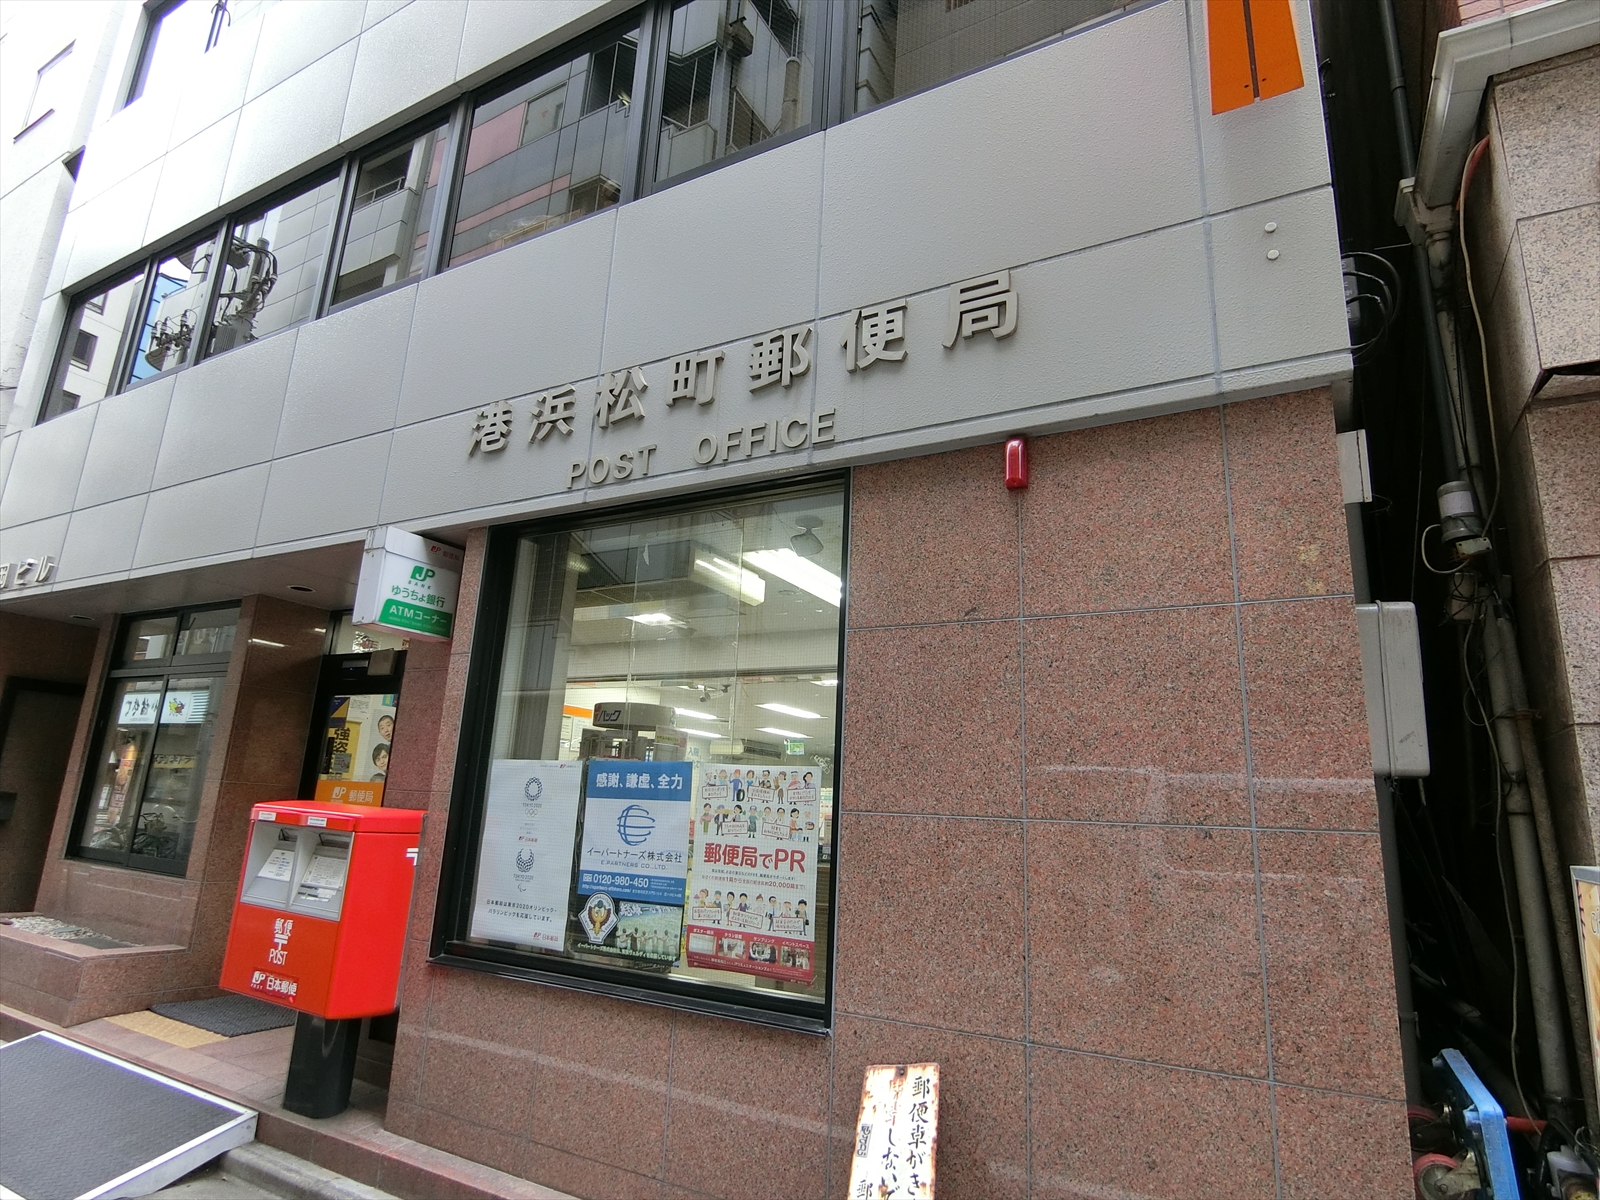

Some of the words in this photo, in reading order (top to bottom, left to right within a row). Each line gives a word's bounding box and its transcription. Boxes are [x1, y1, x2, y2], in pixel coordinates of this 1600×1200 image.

[468, 270, 1019, 457] 港浜松町郵便局
[566, 444, 657, 489] POST
[693, 407, 836, 464] OFFICE
[410, 565, 436, 582] JP
[408, 581, 432, 590] BANK
[391, 585, 446, 608] ゆうちょ銀行
[389, 605, 447, 624] ATMコーナー
[596, 773, 684, 790] 感謝、謙虚、全力
[348, 789, 374, 803] 郵便局
[587, 847, 683, 864] イーパートナーズ株式会社
[601, 860, 639, 868] E.PARTNERS
[703, 842, 806, 873] 郵便局でPR
[593, 874, 649, 888] 0120-980-450
[274, 918, 294, 937] 郵便
[268, 948, 288, 966] POST
[252, 970, 266, 984] JP
[266, 976, 298, 996] 日本郵便
